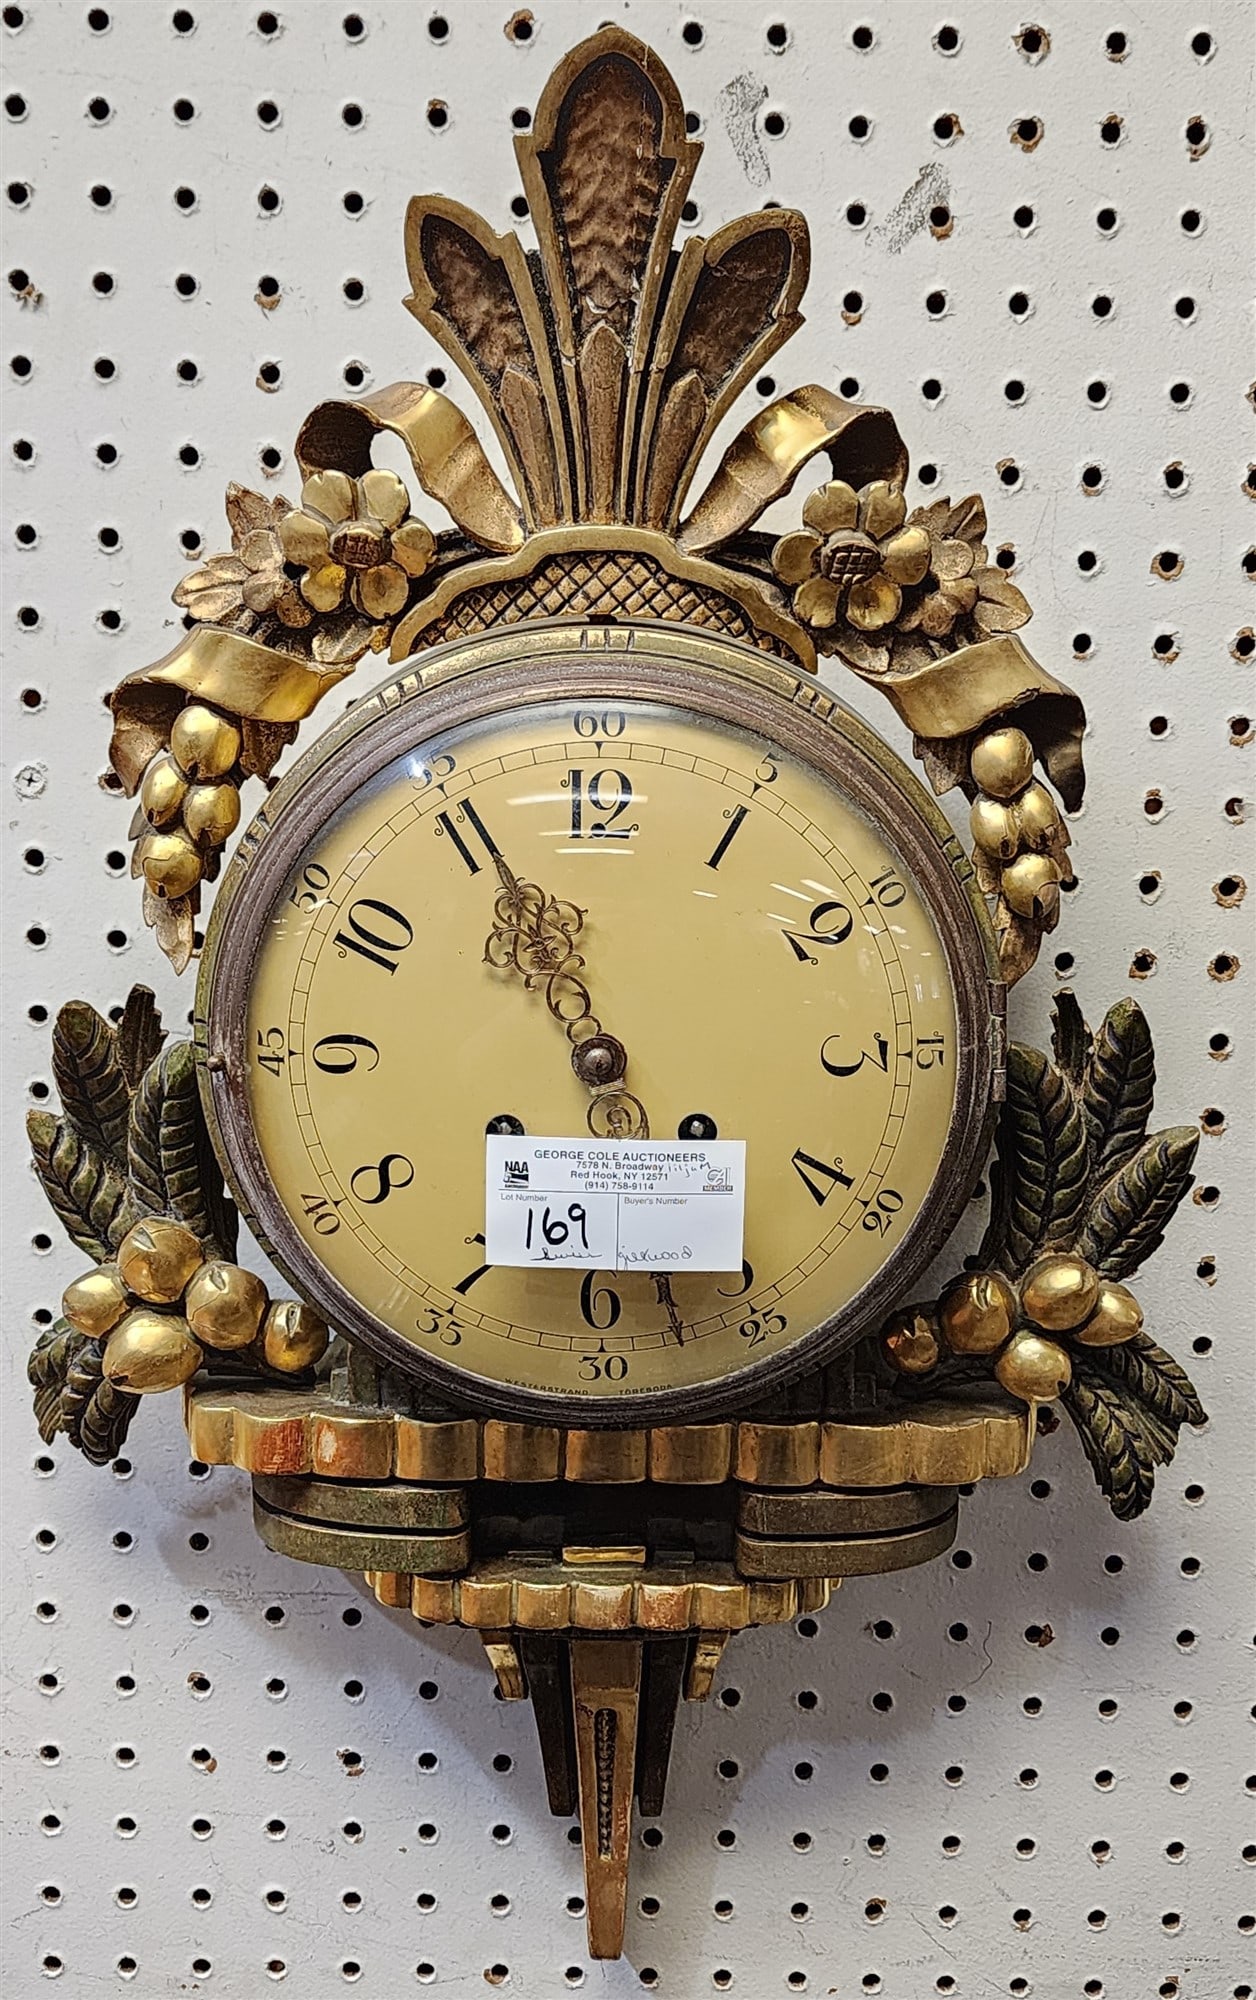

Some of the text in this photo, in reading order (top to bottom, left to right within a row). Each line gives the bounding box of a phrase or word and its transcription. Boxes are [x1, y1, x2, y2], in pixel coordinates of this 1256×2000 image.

[573, 710, 626, 738] 60
[754, 754, 781, 784] 5
[560, 768, 639, 840] 12
[434, 797, 505, 876] 11
[703, 803, 752, 872] 1
[288, 862, 331, 915] 50
[868, 865, 907, 908] 10
[332, 898, 414, 977] 10
[781, 900, 853, 967] 2
[257, 1026, 285, 1078] 45
[312, 1033, 380, 1075] 9
[820, 1031, 889, 1078] 3
[915, 1030, 945, 1070] 15
[504, 1160, 529, 1174] NAA
[534, 1149, 706, 1162] GEORGE COLE AUCTIONEERS
[570, 1170, 668, 1181] Red Hook, NY 12571
[576, 1160, 664, 1172] 7578 N. Broadway
[790, 1147, 857, 1207] 4
[350, 1153, 415, 1205] 8
[500, 1193, 548, 1202] Lot Number
[584, 1180, 654, 1191] (914) 758-9114
[300, 1192, 341, 1236] 40
[624, 1196, 688, 1206] Buyer's Number
[862, 1188, 904, 1238] 20
[526, 1202, 589, 1250] 169
[580, 1270, 621, 1330] 6
[416, 1307, 467, 1347] 35
[738, 1306, 788, 1348] 25
[578, 1355, 629, 1381] 30
